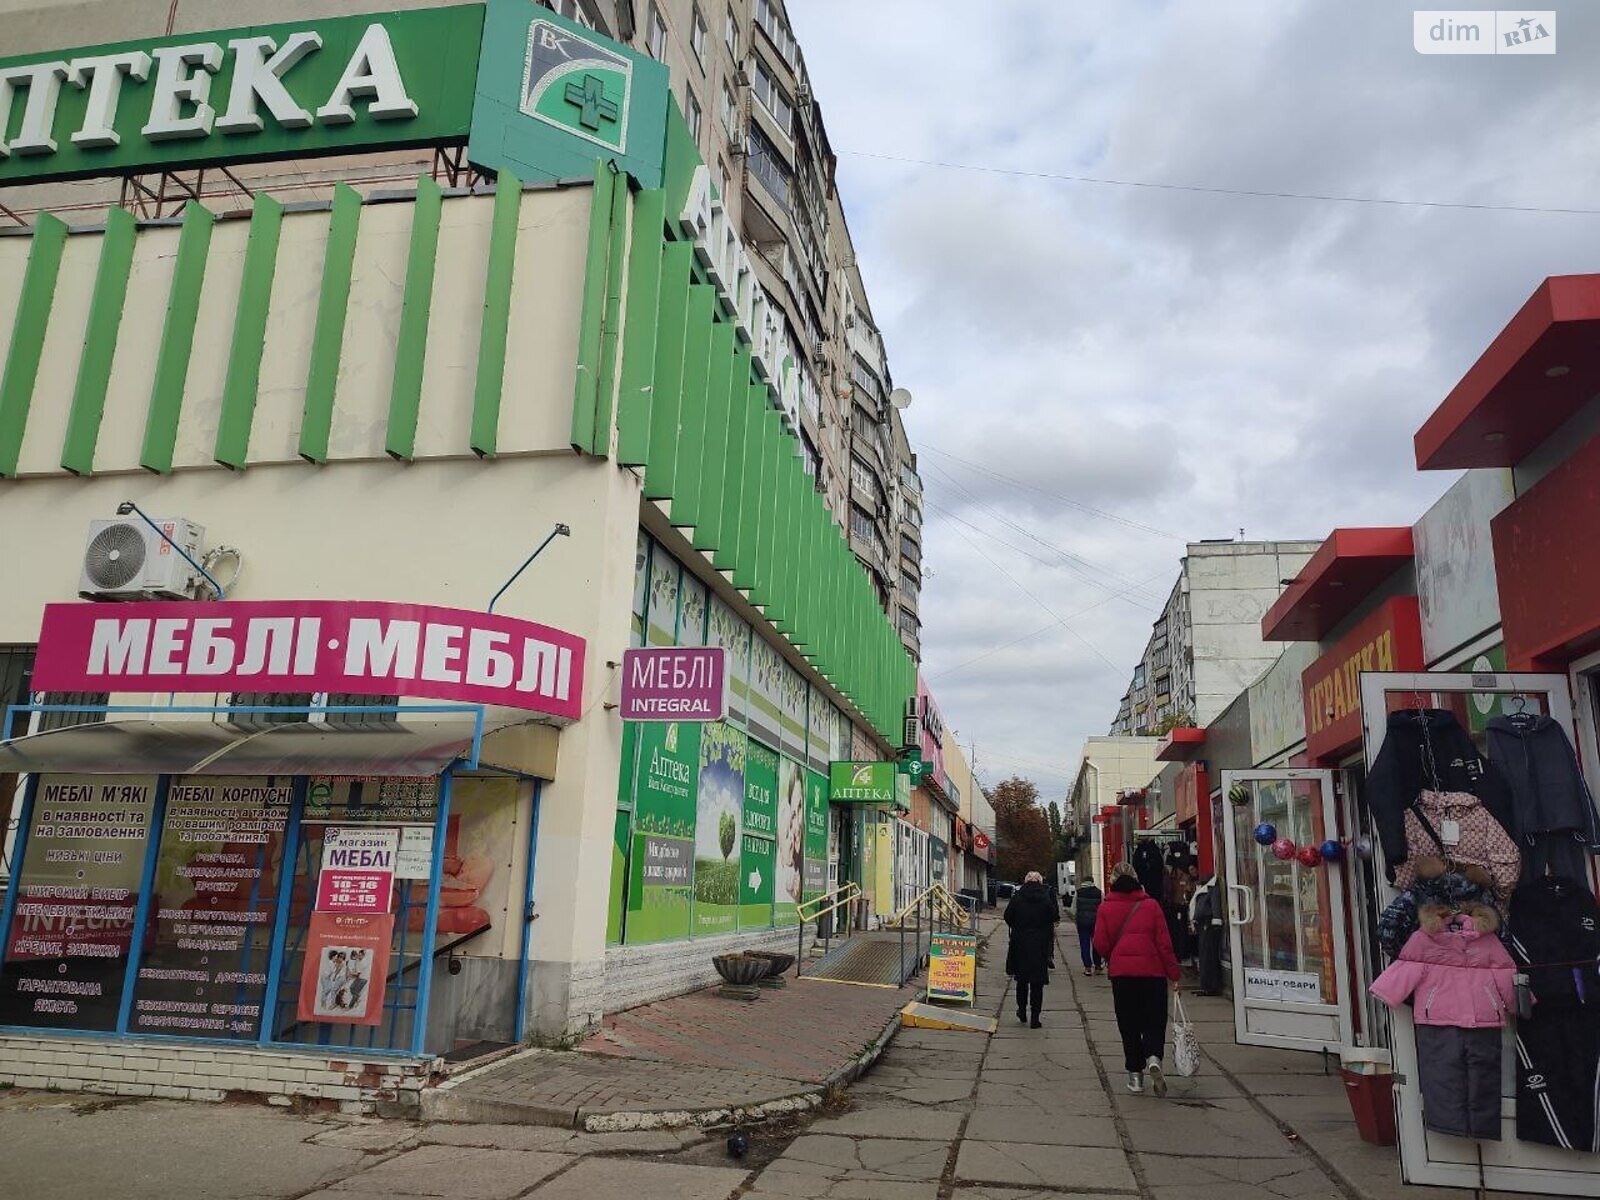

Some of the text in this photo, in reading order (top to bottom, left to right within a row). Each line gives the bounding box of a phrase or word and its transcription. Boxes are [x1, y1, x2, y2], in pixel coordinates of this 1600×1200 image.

[87, 617, 573, 700] МЕБЛІ МЕБЛІ
[631, 656, 714, 689] МЕБЛІ
[631, 698, 711, 713] INTEGRAL
[650, 746, 690, 784] Аптека
[44, 785, 148, 803] МЕБЛІ М'ЯКІ
[170, 787, 293, 804] МЕБЛІ КОРПУСНІ
[833, 788, 892, 800] АПТЕКА
[43, 809, 144, 822] в наявності та
[169, 809, 176, 817] в
[250, 808, 288, 819] також
[36, 827, 145, 838] на замовлення
[169, 820, 286, 833] по вашим розмірам
[179, 832, 269, 843] та побажанням
[47, 850, 122, 863] НИЗЬКІ ЦІНИ
[329, 849, 391, 866] МЕБЛІ
[27, 885, 129, 900] ШИРОКИЙ ВИБІР
[17, 978, 102, 995] ГАРАНТОВАНА
